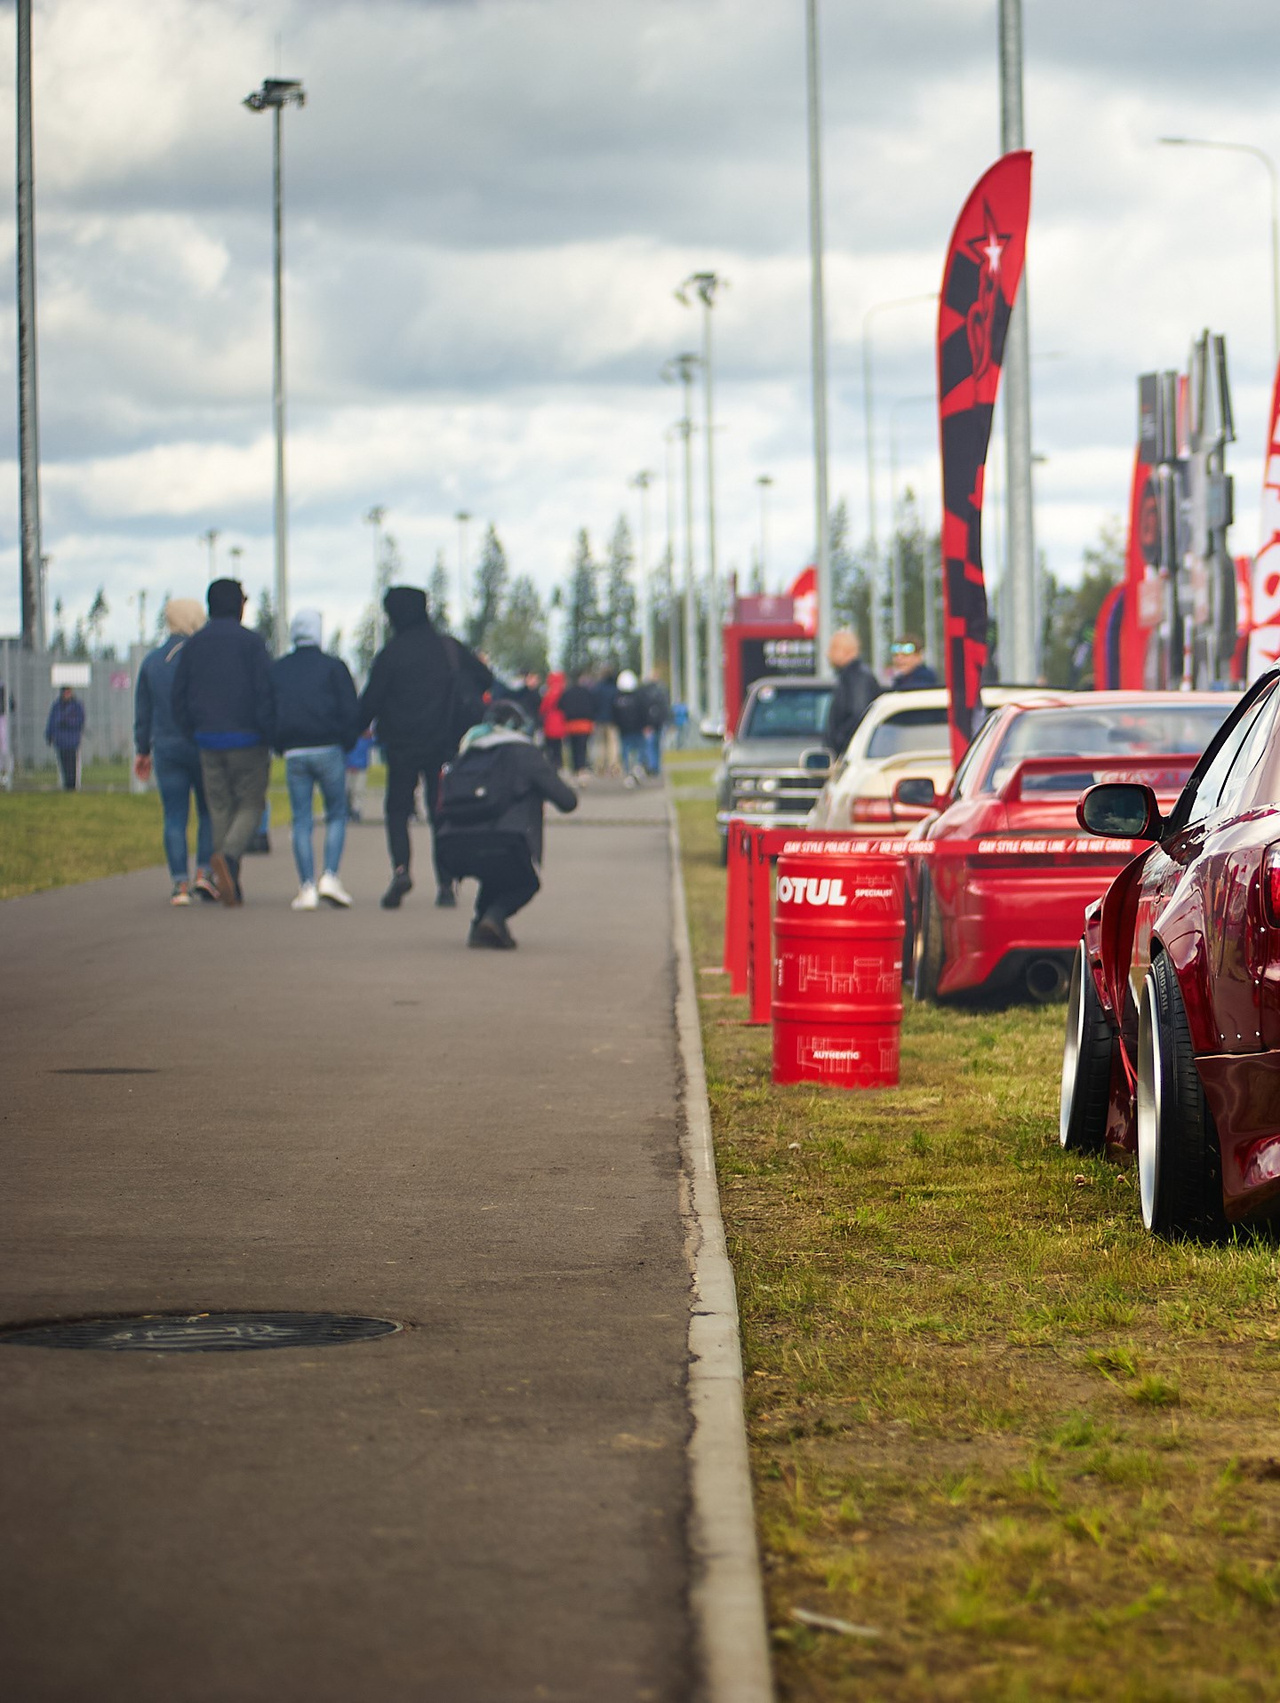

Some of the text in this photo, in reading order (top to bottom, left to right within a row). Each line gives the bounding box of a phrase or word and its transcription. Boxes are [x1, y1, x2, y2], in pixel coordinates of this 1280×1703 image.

[824, 840, 851, 854] POLICE
[851, 840, 869, 854] LINE
[879, 840, 891, 854] DO
[892, 840, 908, 854] NOT
[908, 840, 935, 854] CROSS
[1019, 839, 1047, 853] POLICE
[1047, 839, 1066, 853] LINE
[1076, 839, 1089, 853] DO
[1088, 839, 1105, 853] NOT
[1105, 839, 1132, 853] CROSS
[776, 875, 847, 906] OTUL
[855, 888, 893, 898] SPECIALIST
[812, 1050, 860, 1060] AUTHENTIC
